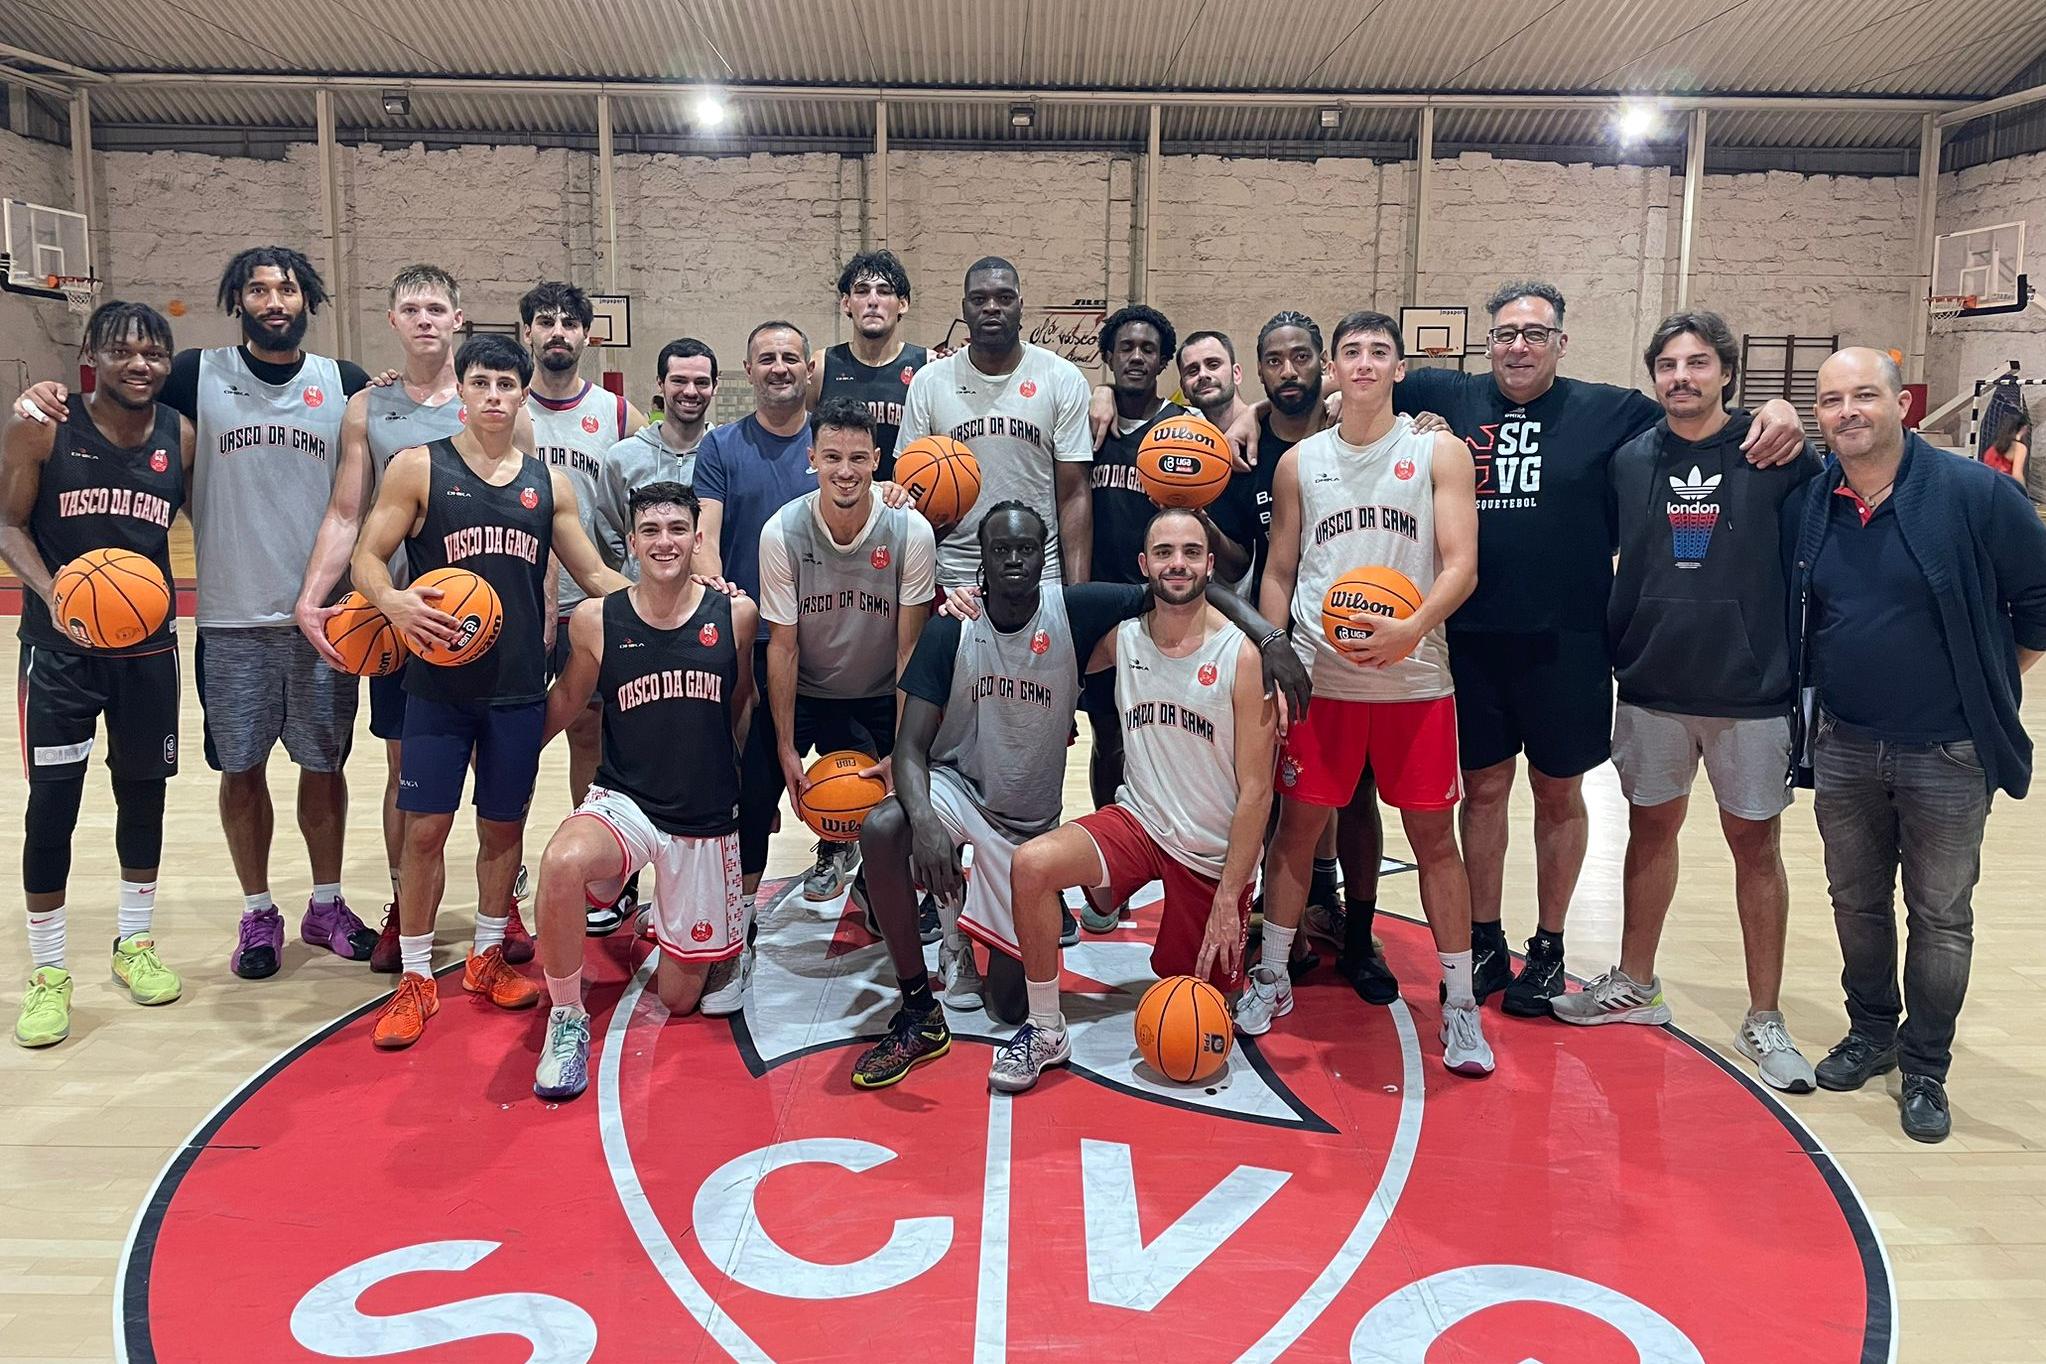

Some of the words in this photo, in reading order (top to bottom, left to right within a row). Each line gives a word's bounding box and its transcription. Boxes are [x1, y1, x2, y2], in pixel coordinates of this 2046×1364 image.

[886, 402, 906, 426] GA
[219, 425, 262, 456] VASCO
[267, 425, 286, 447] DA
[291, 428, 327, 462] GAMA
[950, 417, 985, 444] VASCO
[989, 416, 1005, 436] DA
[1009, 418, 1042, 447] GAMA
[1153, 426, 1216, 450] Wilson
[1497, 421, 1541, 455] SC
[551, 447, 566, 465] DA
[571, 450, 600, 480] GAMA
[1090, 464, 1110, 489] SCO
[1110, 464, 1127, 488] DA
[1127, 466, 1146, 494] GA
[1495, 455, 1542, 493] VG
[59, 488, 109, 518] VASCO
[110, 488, 132, 516] DA
[132, 492, 171, 529] GAMA
[1476, 498, 1537, 510] SQUETEBOL
[1666, 501, 1720, 514] london
[1315, 510, 1353, 546] VASCO
[1358, 507, 1377, 529] DA
[1381, 507, 1418, 541] GAMA
[443, 526, 482, 564] VASCO
[484, 525, 503, 554] DA
[505, 528, 539, 565] GAMA
[839, 590, 854, 609] DA
[859, 591, 890, 618] GAMA
[1330, 591, 1395, 618] Wilson
[618, 672, 660, 712] VASCO
[661, 669, 684, 699] DA
[999, 675, 1014, 699] DA
[1019, 679, 1052, 709] GAMA
[1159, 702, 1177, 726] DA
[1180, 706, 1216, 745] GAMA
[821, 816, 862, 833] Wils
[692, 1136, 954, 1300] C
[1080, 1137, 1293, 1312] V
